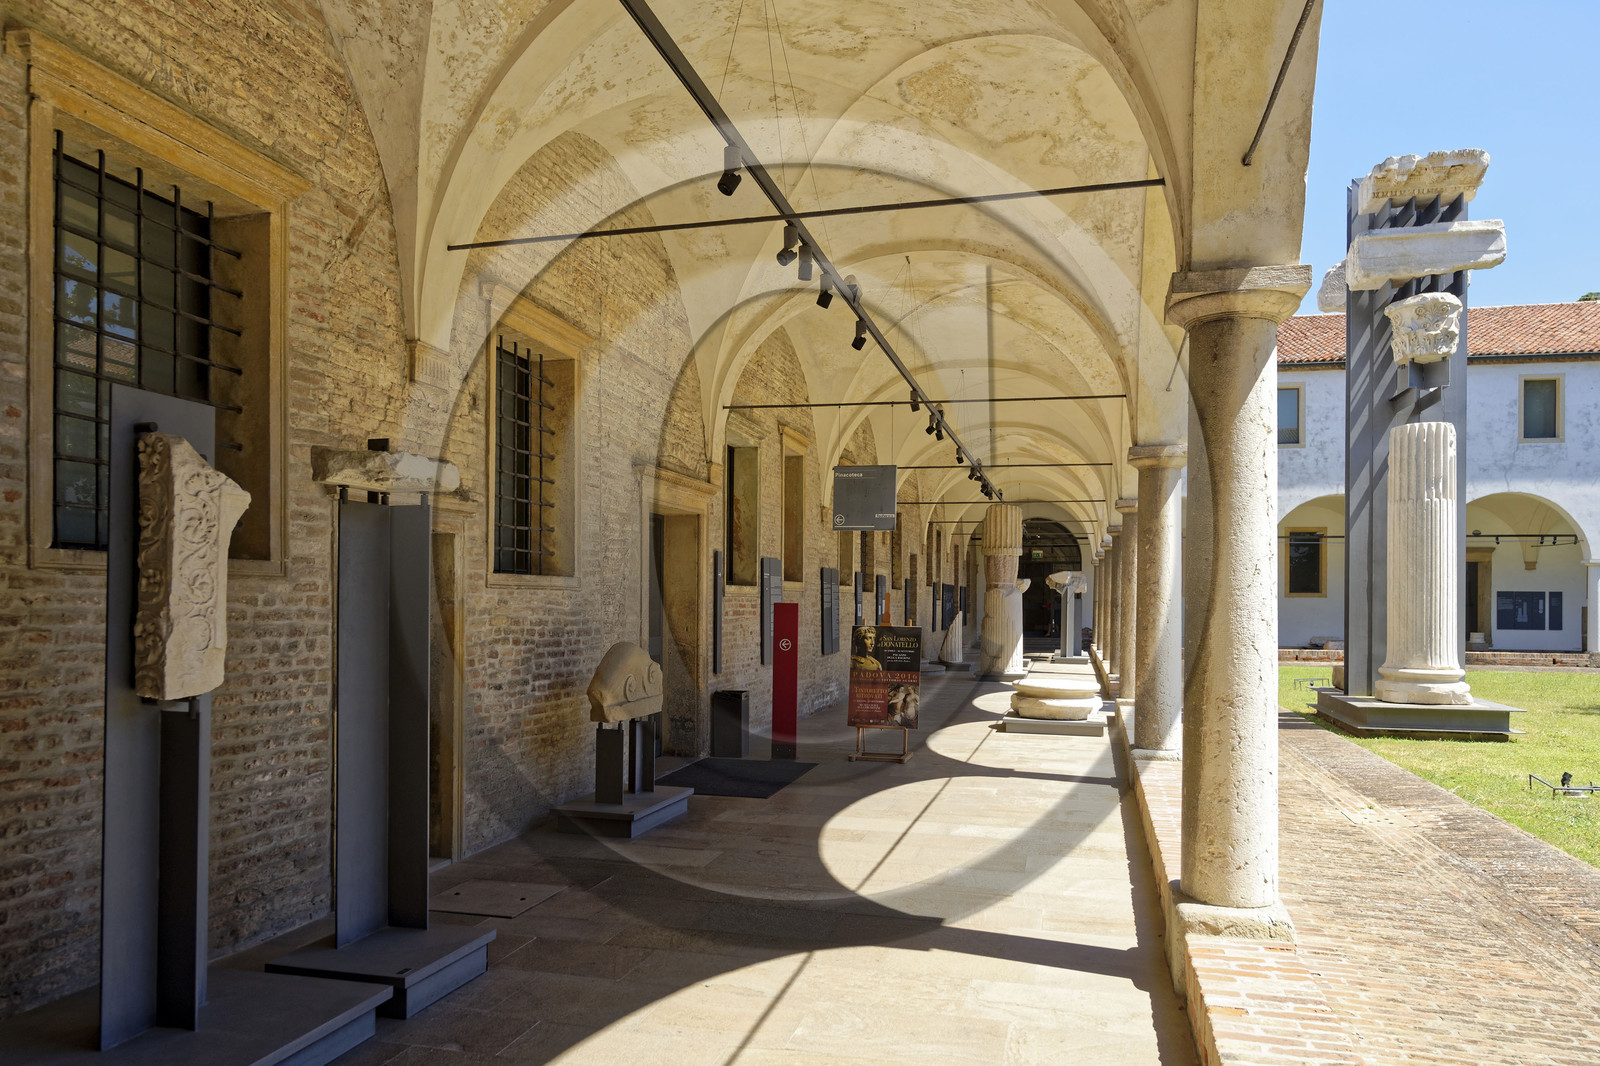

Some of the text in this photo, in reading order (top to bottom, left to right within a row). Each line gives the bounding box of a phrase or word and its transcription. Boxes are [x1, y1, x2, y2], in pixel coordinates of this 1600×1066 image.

[853, 671, 891, 679] PADOVA
[894, 672, 918, 680] 2016
[854, 686, 888, 694] TINTORETTO
